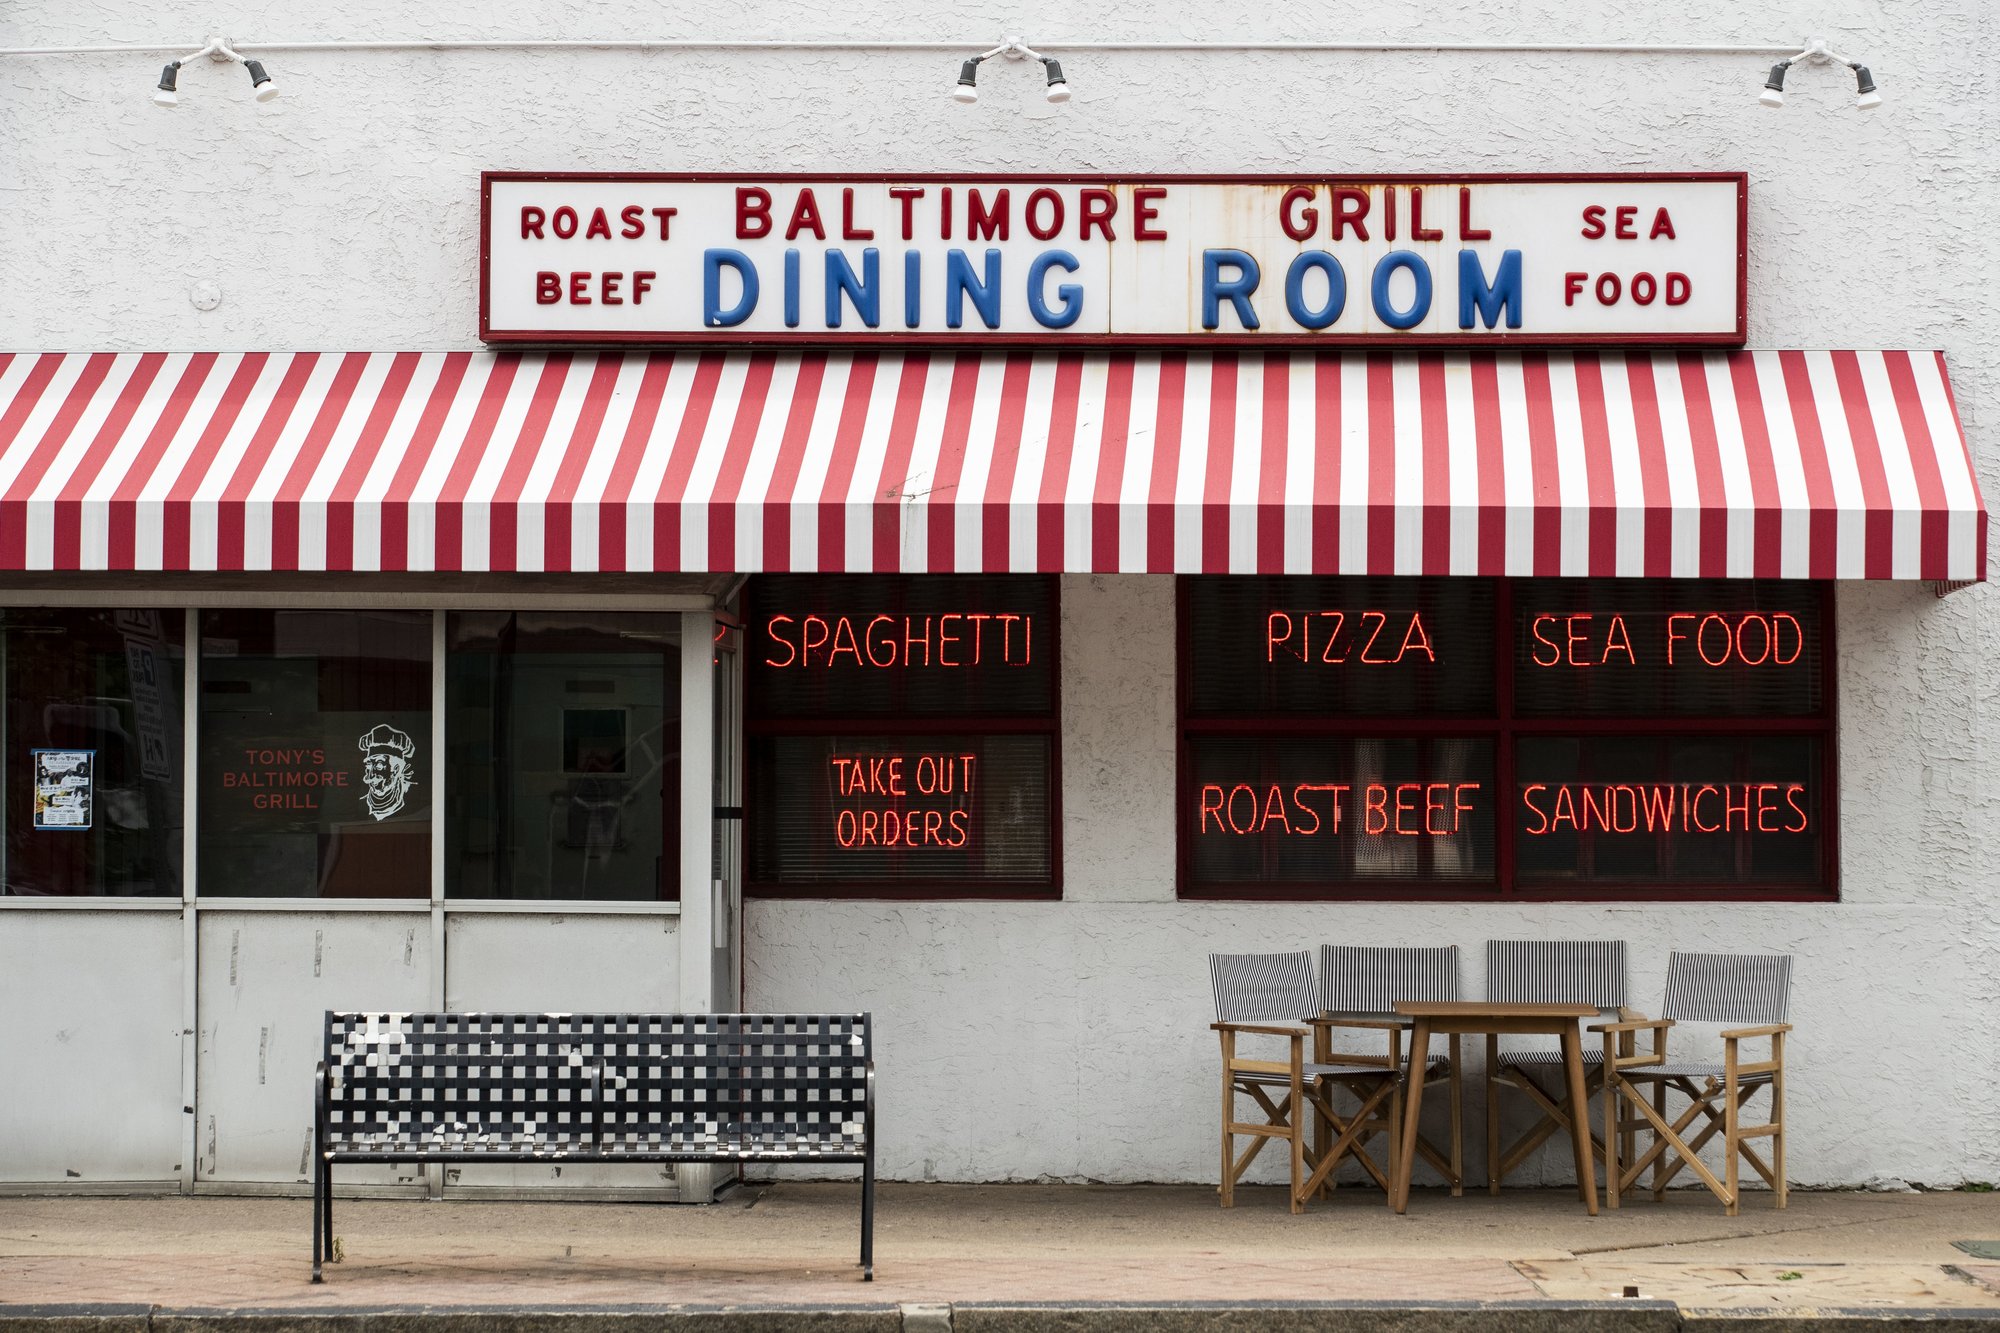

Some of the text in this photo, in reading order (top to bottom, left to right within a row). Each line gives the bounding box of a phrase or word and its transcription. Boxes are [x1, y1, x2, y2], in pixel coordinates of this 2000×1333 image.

[520, 205, 679, 241] ROAST
[736, 186, 1491, 242] BALTIMORE GRILL
[1581, 205, 1676, 240] SEA
[536, 270, 657, 306] BEEF
[703, 247, 1523, 330] DINING ROOM
[1564, 271, 1692, 306] FOOD
[766, 613, 1032, 668] SPAGHETTI
[1267, 610, 1437, 664] PIZZA
[1532, 612, 1803, 667] SEA FOOD
[246, 749, 326, 765] TONY'S
[832, 755, 976, 797] TAKE OUT
[223, 771, 349, 787] BALTIMORE
[253, 794, 318, 809] GRILL
[1200, 783, 1480, 836] ROAST BEEF
[1523, 783, 1809, 836] SANDWICHES
[836, 810, 969, 849] ORDERS
